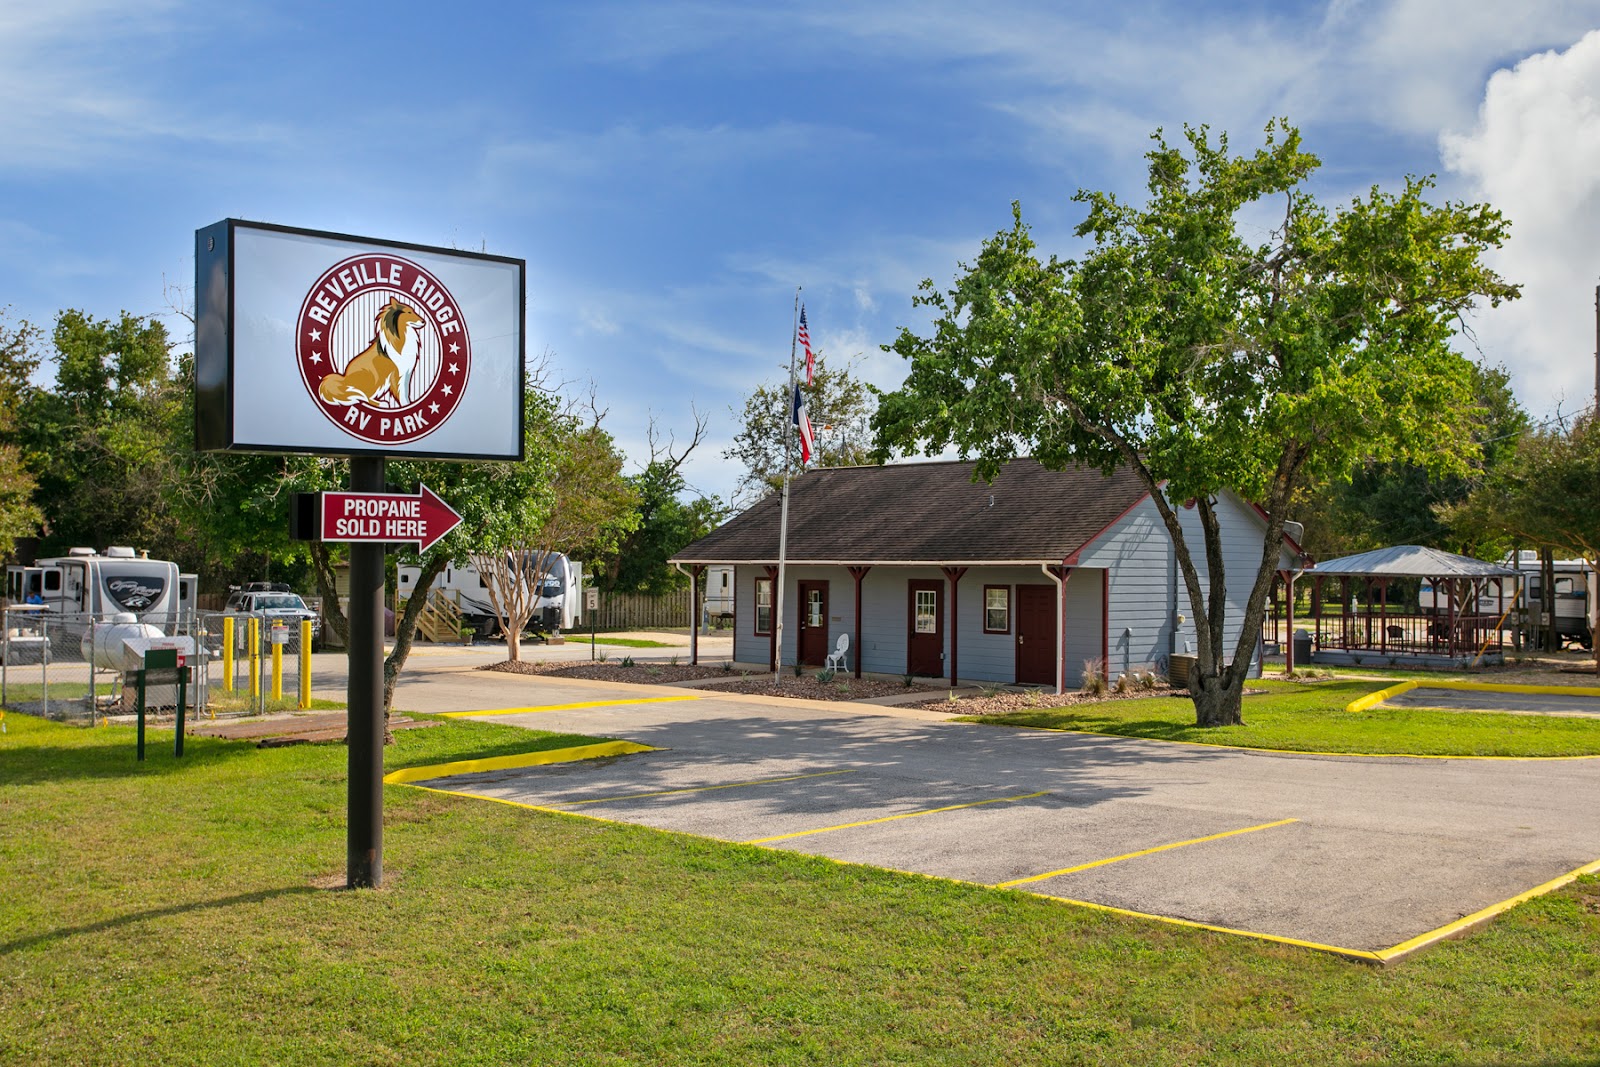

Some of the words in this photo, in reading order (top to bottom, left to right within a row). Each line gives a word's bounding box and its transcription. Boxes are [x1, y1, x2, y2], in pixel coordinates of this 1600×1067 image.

[308, 262, 403, 326] REVEILLE
[411, 274, 461, 337] RIDGE
[344, 405, 372, 431] RV
[380, 409, 429, 436] PARK
[344, 499, 421, 518] PROPANE
[336, 519, 380, 536] SOLD
[385, 520, 427, 537] HERE
[590, 600, 595, 608] 5
